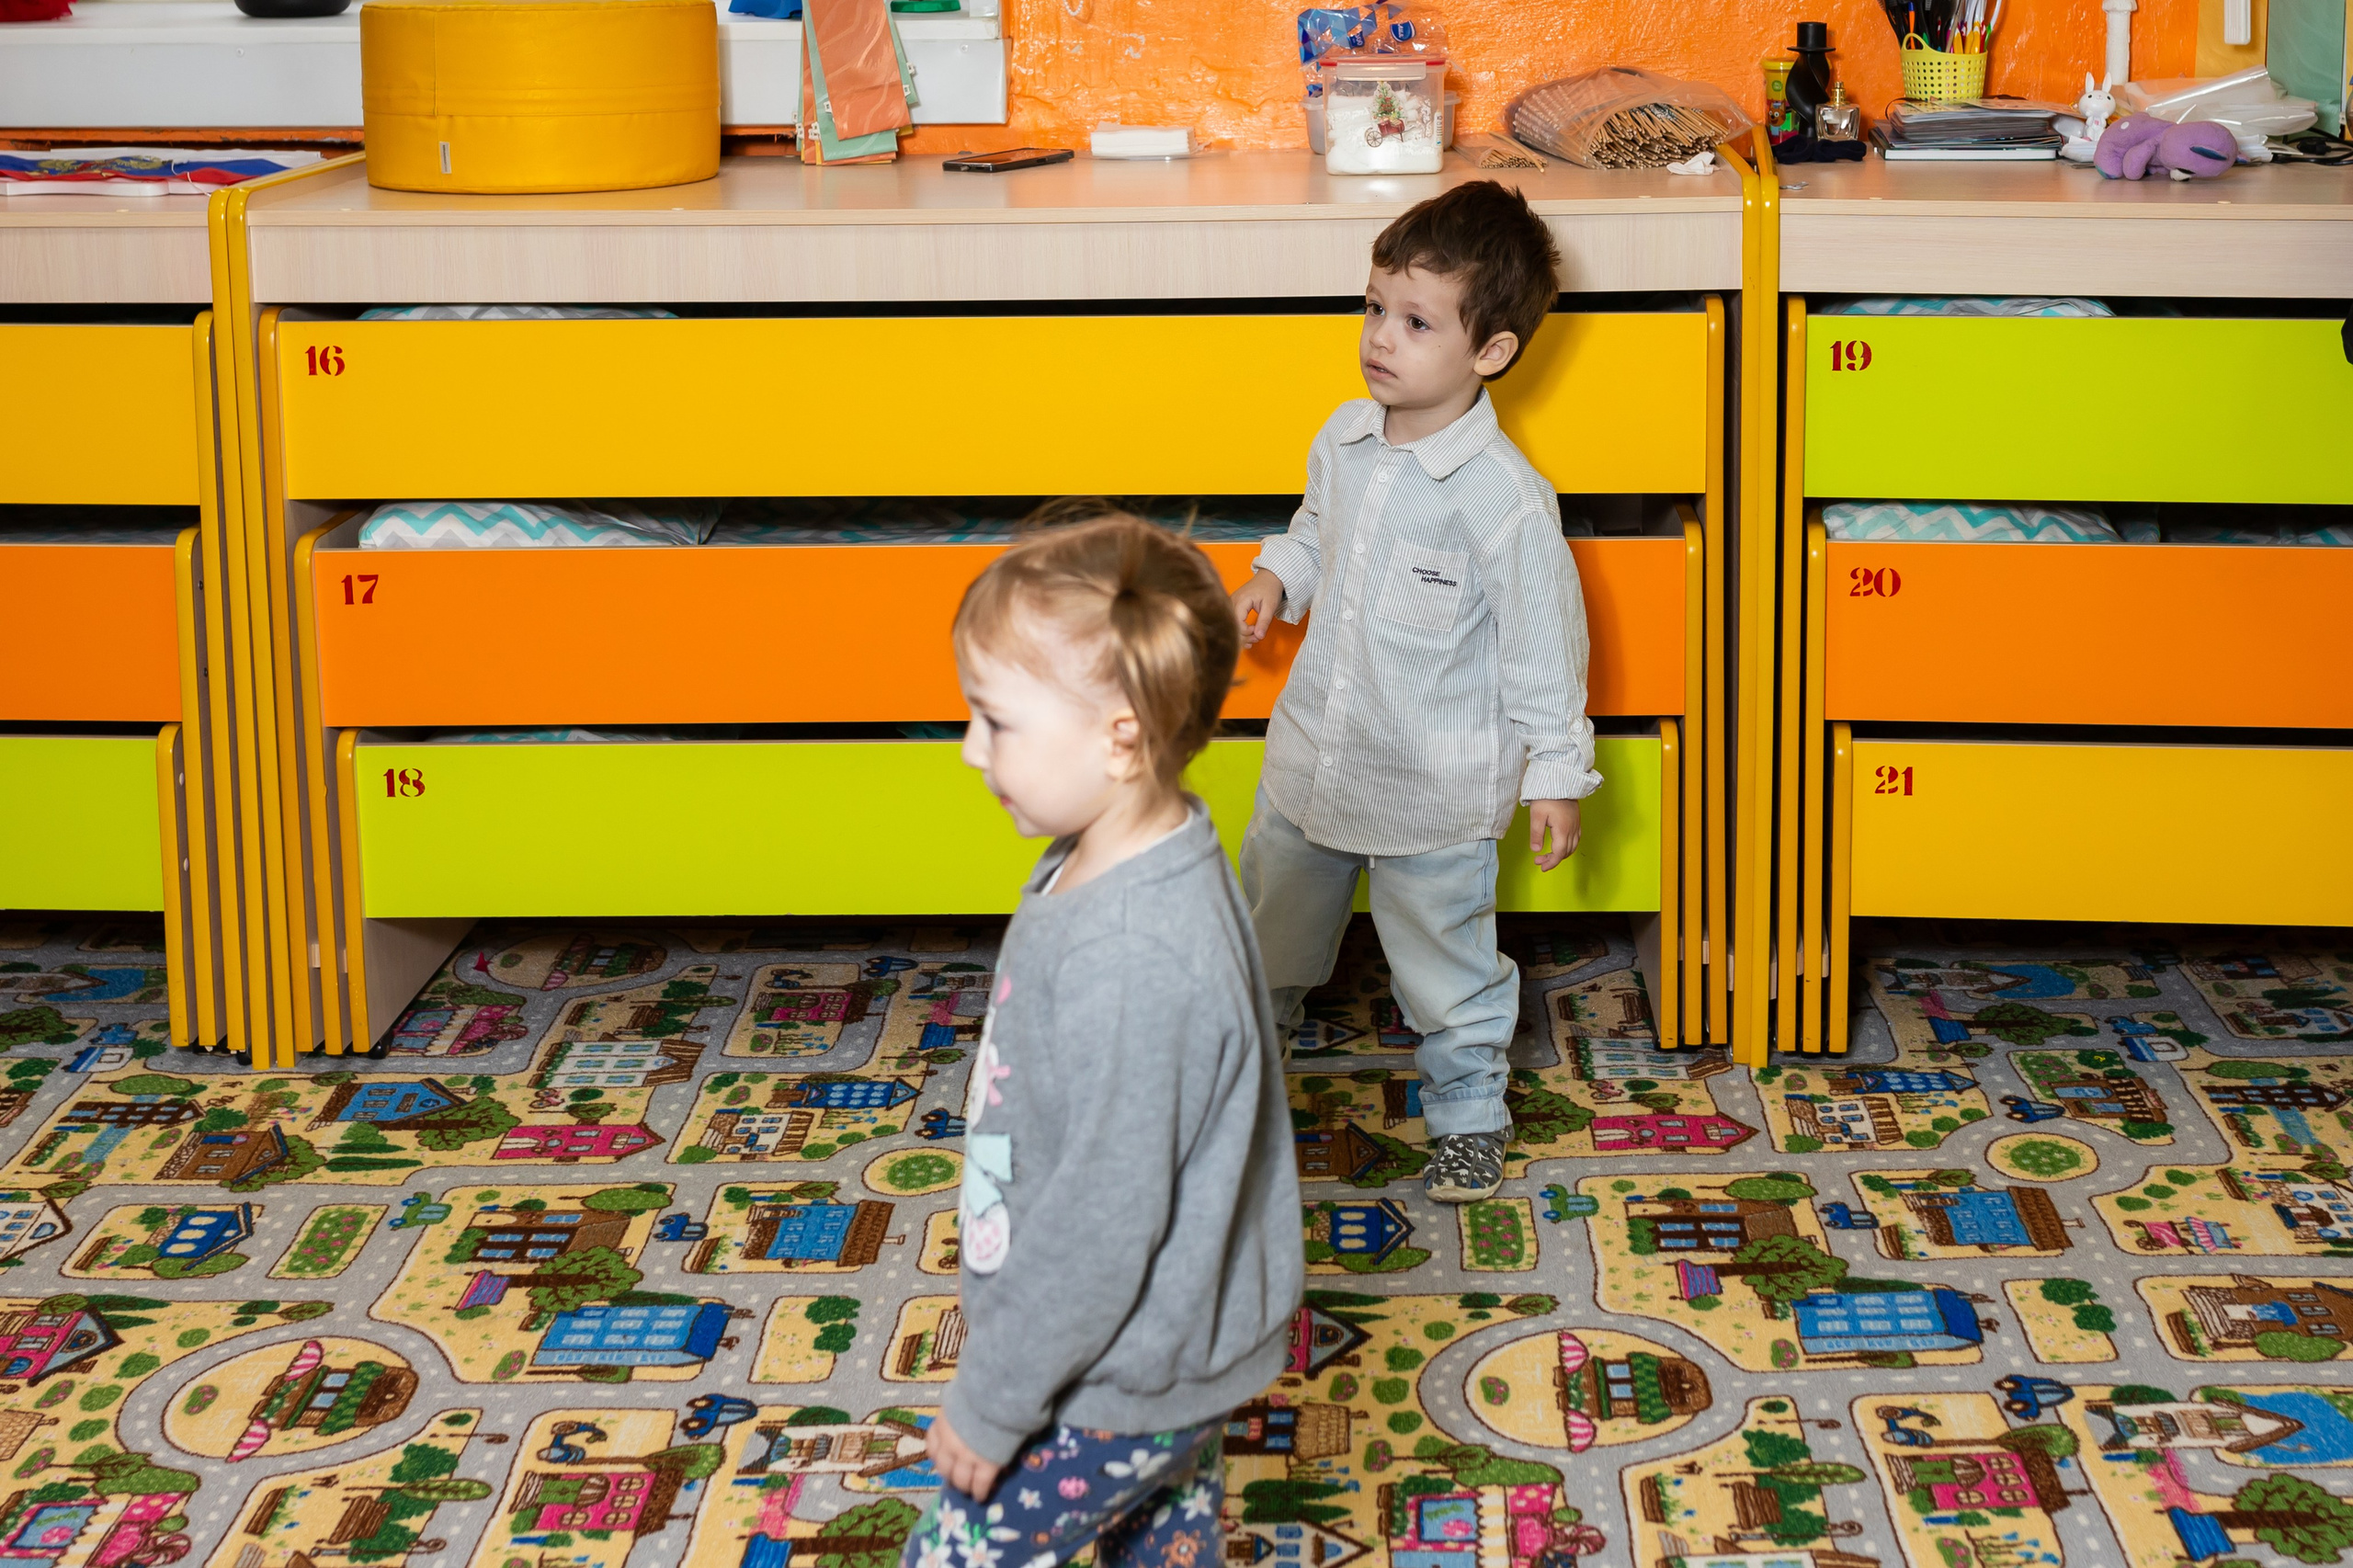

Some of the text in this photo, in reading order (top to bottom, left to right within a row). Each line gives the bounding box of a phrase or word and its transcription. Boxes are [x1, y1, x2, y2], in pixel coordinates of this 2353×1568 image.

[305, 346, 345, 376] 16
[1830, 341, 1871, 371] 19
[1412, 566, 1440, 576] CHOOSE
[1421, 575, 1458, 587] HAPPINESS
[1849, 567, 1901, 597] 20
[341, 574, 379, 605] 17
[383, 768, 425, 797] 18
[1875, 766, 1913, 796] 21
